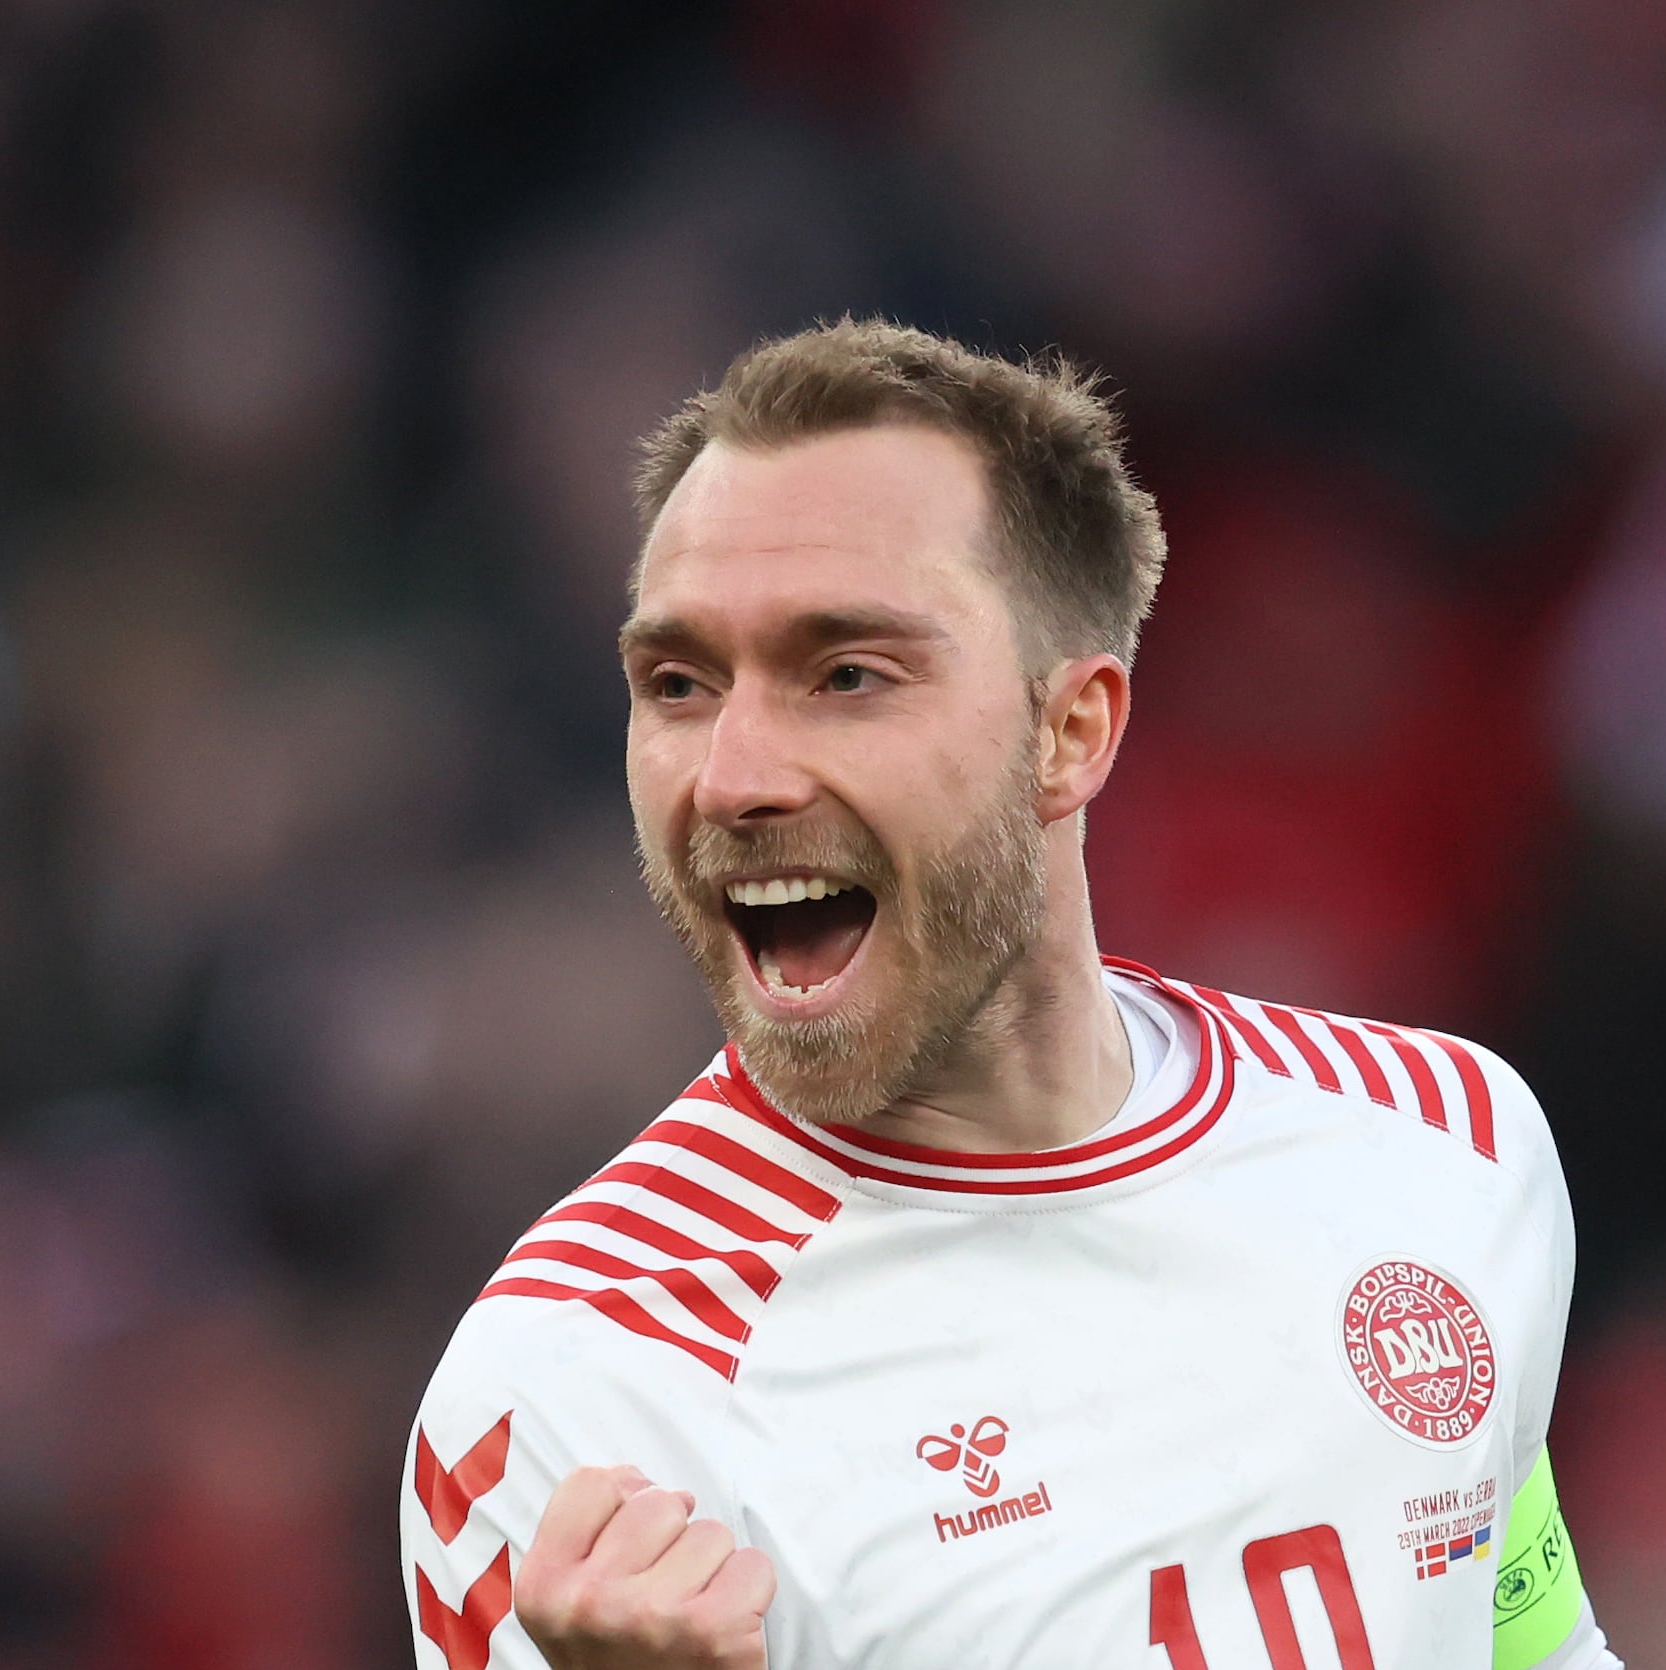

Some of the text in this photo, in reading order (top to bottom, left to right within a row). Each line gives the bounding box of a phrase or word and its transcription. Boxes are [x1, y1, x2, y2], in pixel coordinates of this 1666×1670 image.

[1373, 1317, 1464, 1380] DBU
[1346, 1324, 1414, 1427] DANSK
[1423, 1410, 1473, 1440] 1889
[933, 1481, 1053, 1544] hummel
[1403, 1489, 1460, 1522] DENMARK
[1397, 1528, 1422, 1550] 29TH
[1423, 1521, 1450, 1542] MARCH
[1452, 1516, 1469, 1536] 2022
